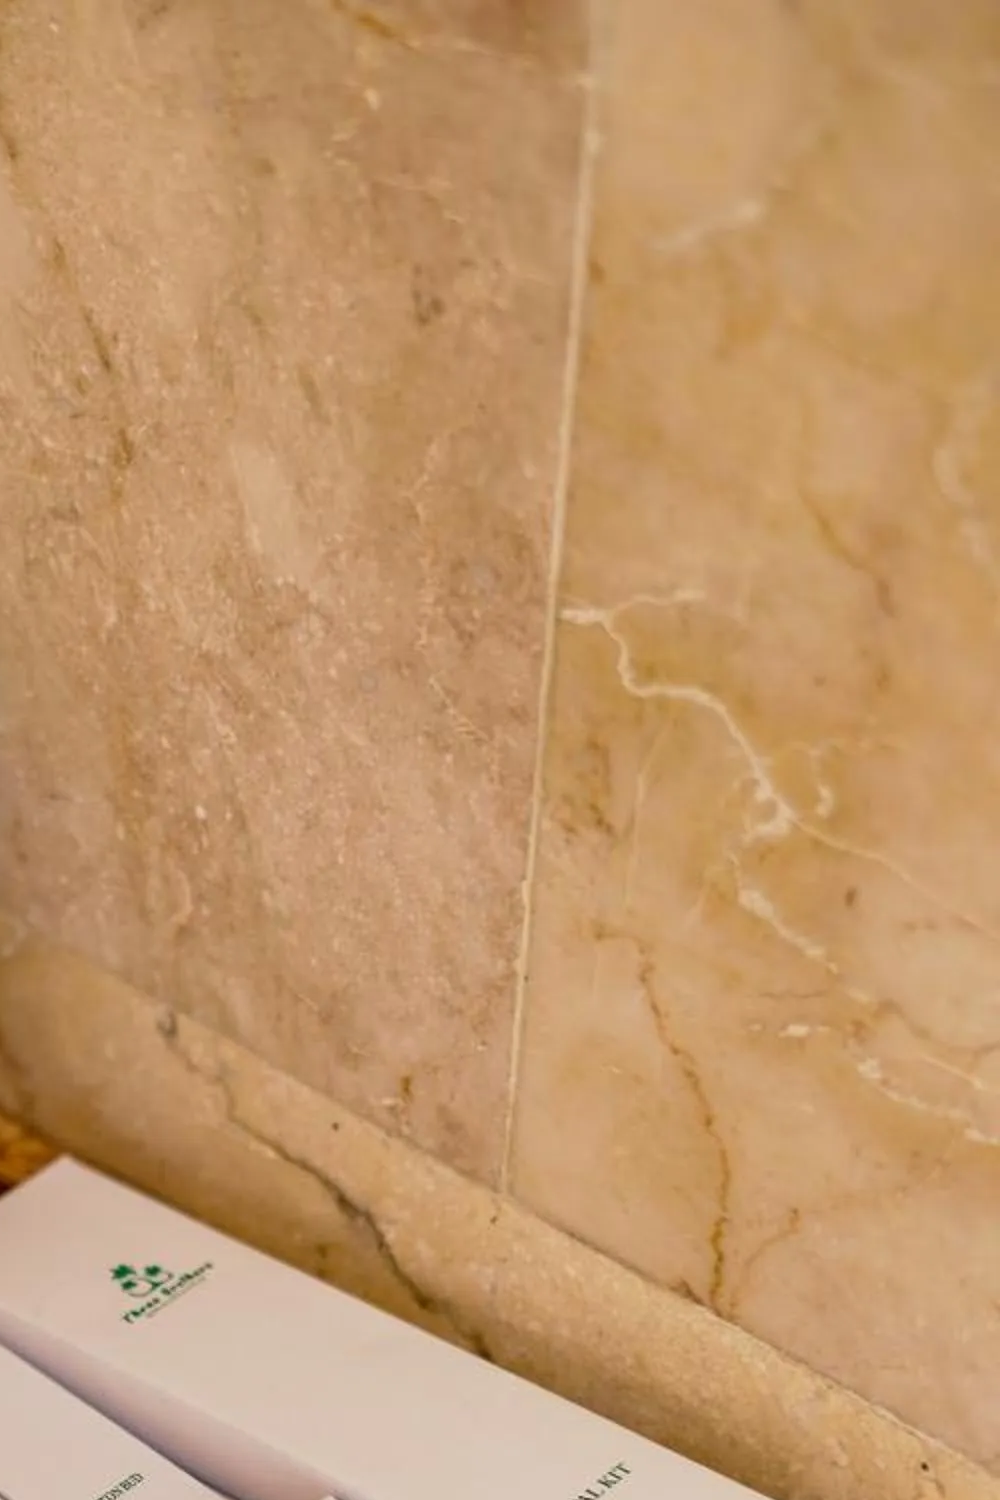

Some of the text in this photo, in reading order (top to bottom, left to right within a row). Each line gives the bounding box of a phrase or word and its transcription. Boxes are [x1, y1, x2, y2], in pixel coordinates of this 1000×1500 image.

[120, 1297, 160, 1324] Three
[161, 1261, 213, 1296] Brothers
[119, 1473, 145, 1491] BUD
[597, 1461, 631, 1489] KIT
